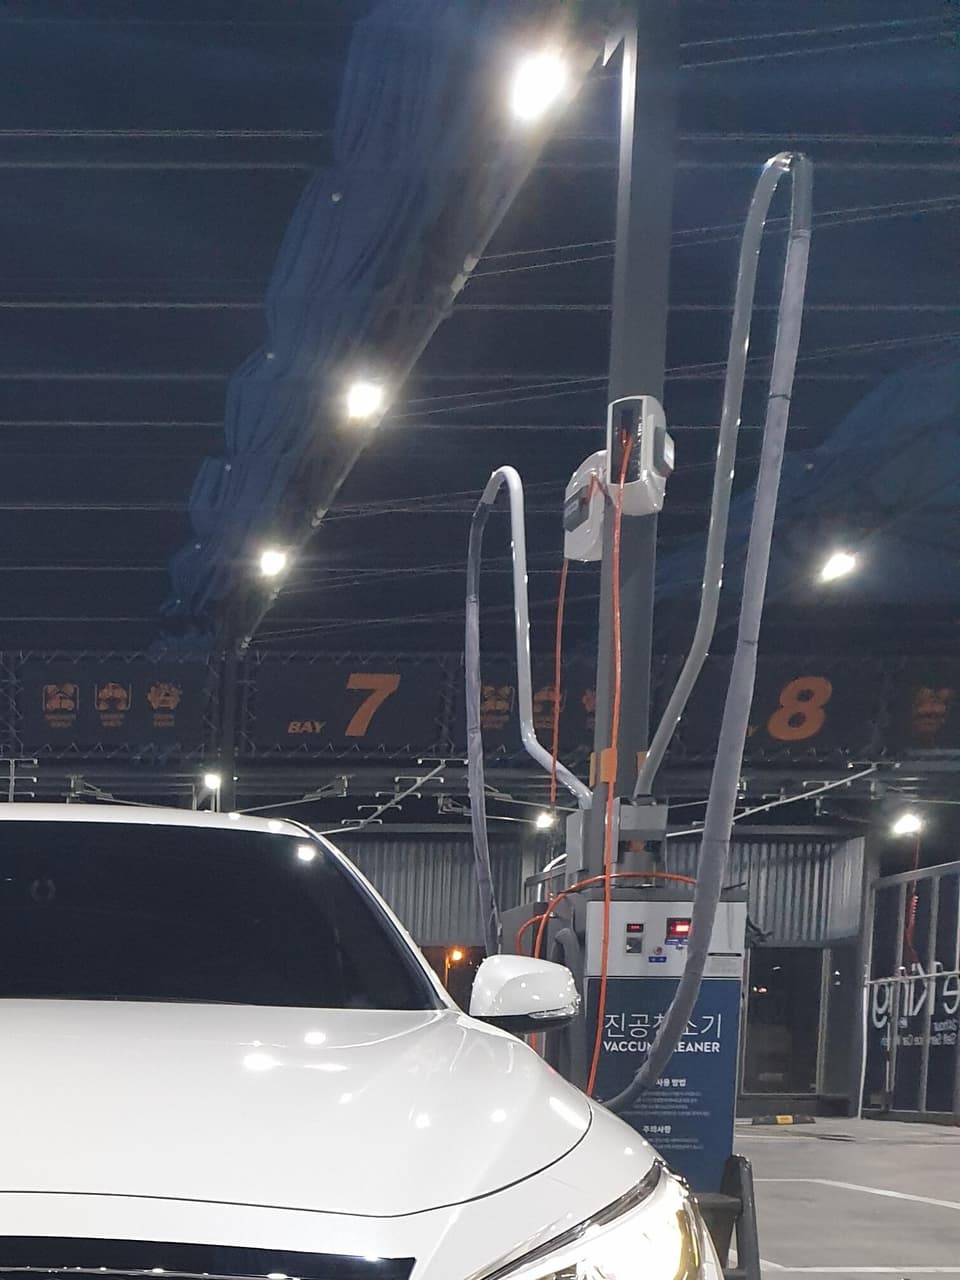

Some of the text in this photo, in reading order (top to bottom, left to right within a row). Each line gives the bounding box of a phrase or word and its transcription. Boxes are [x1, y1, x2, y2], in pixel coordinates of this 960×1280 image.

[287, 673, 401, 736] BAY 7
[767, 676, 832, 740] 8
[604, 1012, 721, 1039] 진공소기
[673, 1041, 720, 1053] EANER
